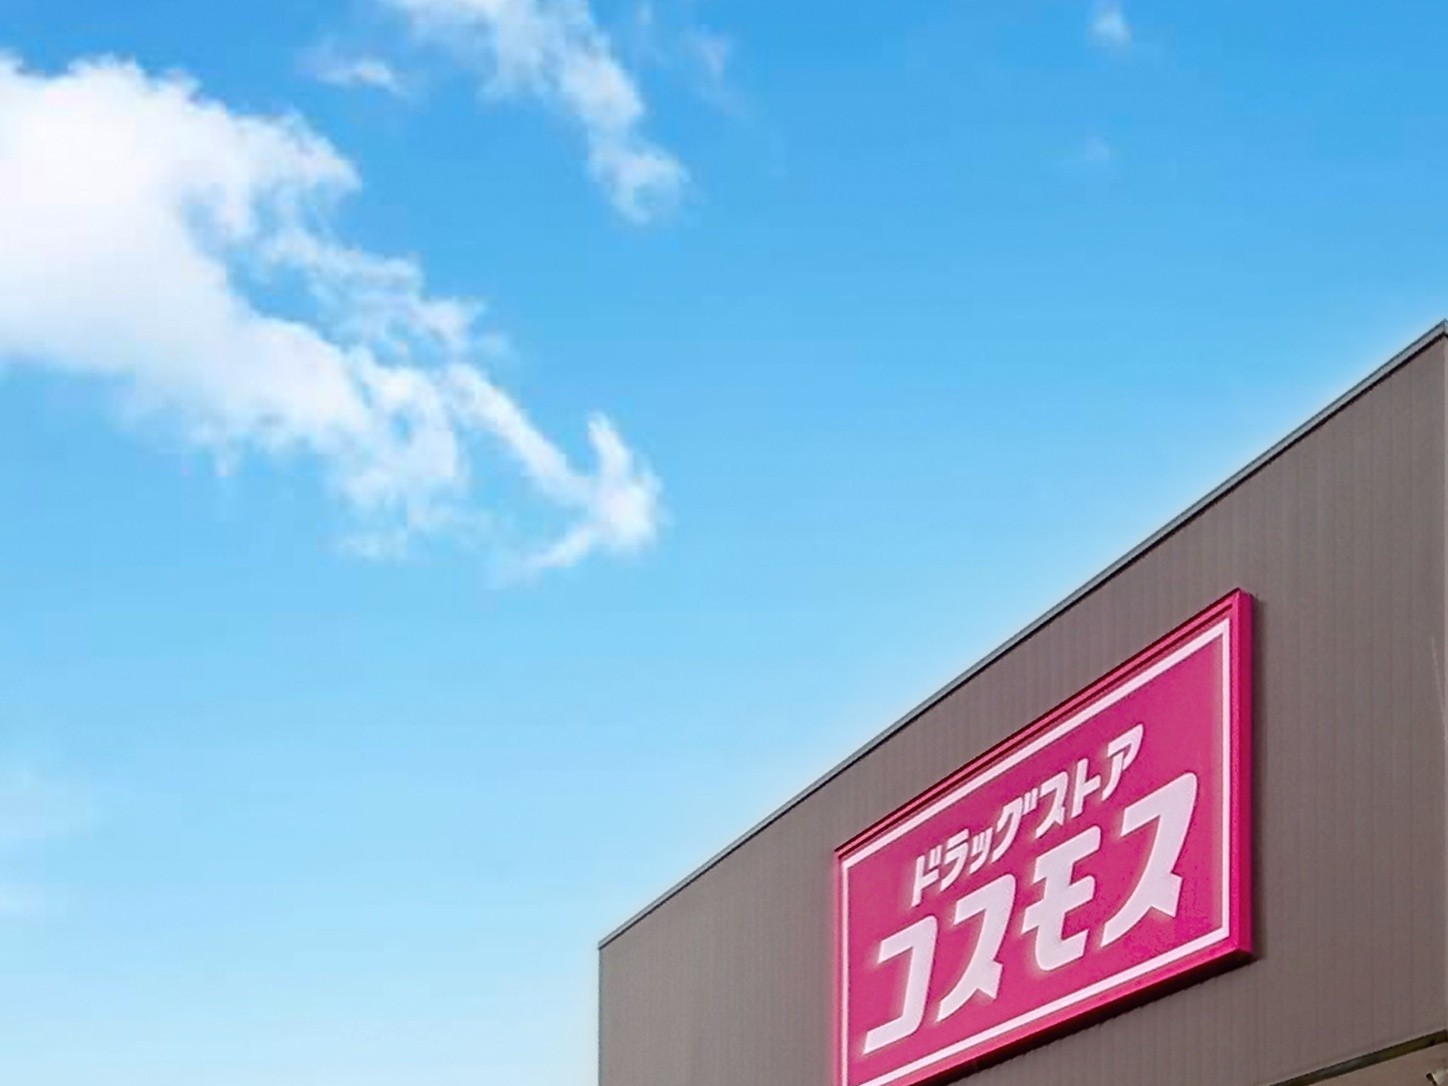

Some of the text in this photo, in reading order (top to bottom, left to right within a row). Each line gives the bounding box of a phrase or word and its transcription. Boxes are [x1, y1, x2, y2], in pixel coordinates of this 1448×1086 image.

[863, 772, 1198, 1054] コスモス
[911, 724, 1144, 906] ドラッグストア
